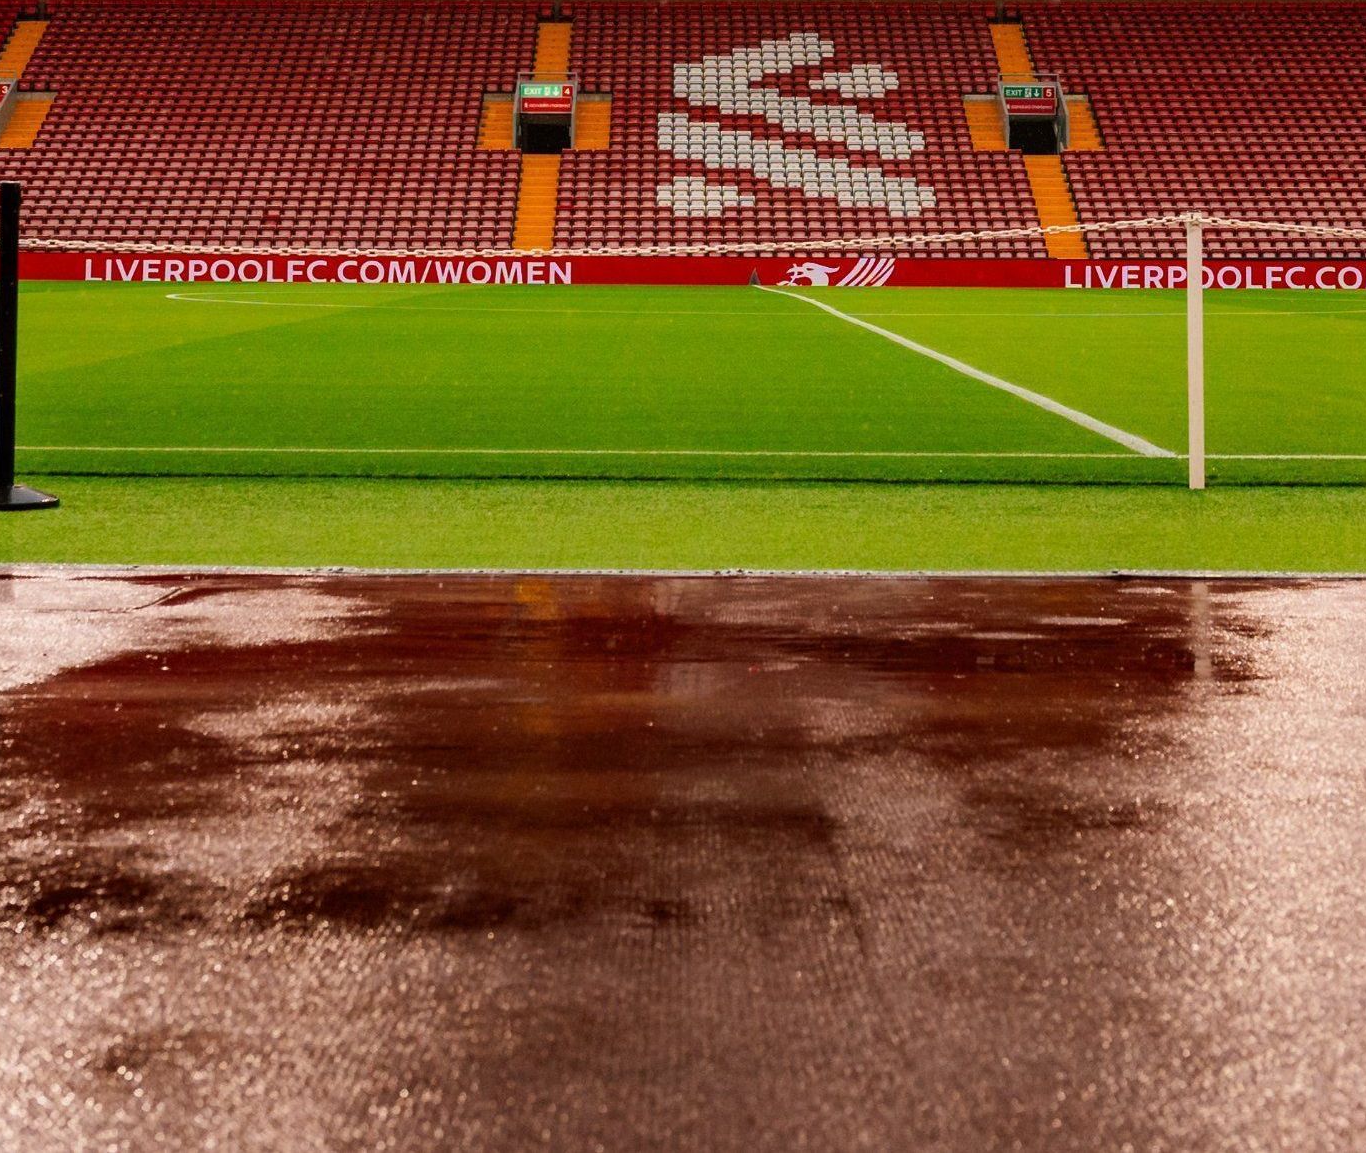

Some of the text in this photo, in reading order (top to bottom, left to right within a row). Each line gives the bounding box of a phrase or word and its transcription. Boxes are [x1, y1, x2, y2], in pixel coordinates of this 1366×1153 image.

[1, 86, 8, 94] 3
[1045, 88, 1053, 97] 5
[84, 258, 572, 284] LIVERPOOLFC.COM/WOMEN
